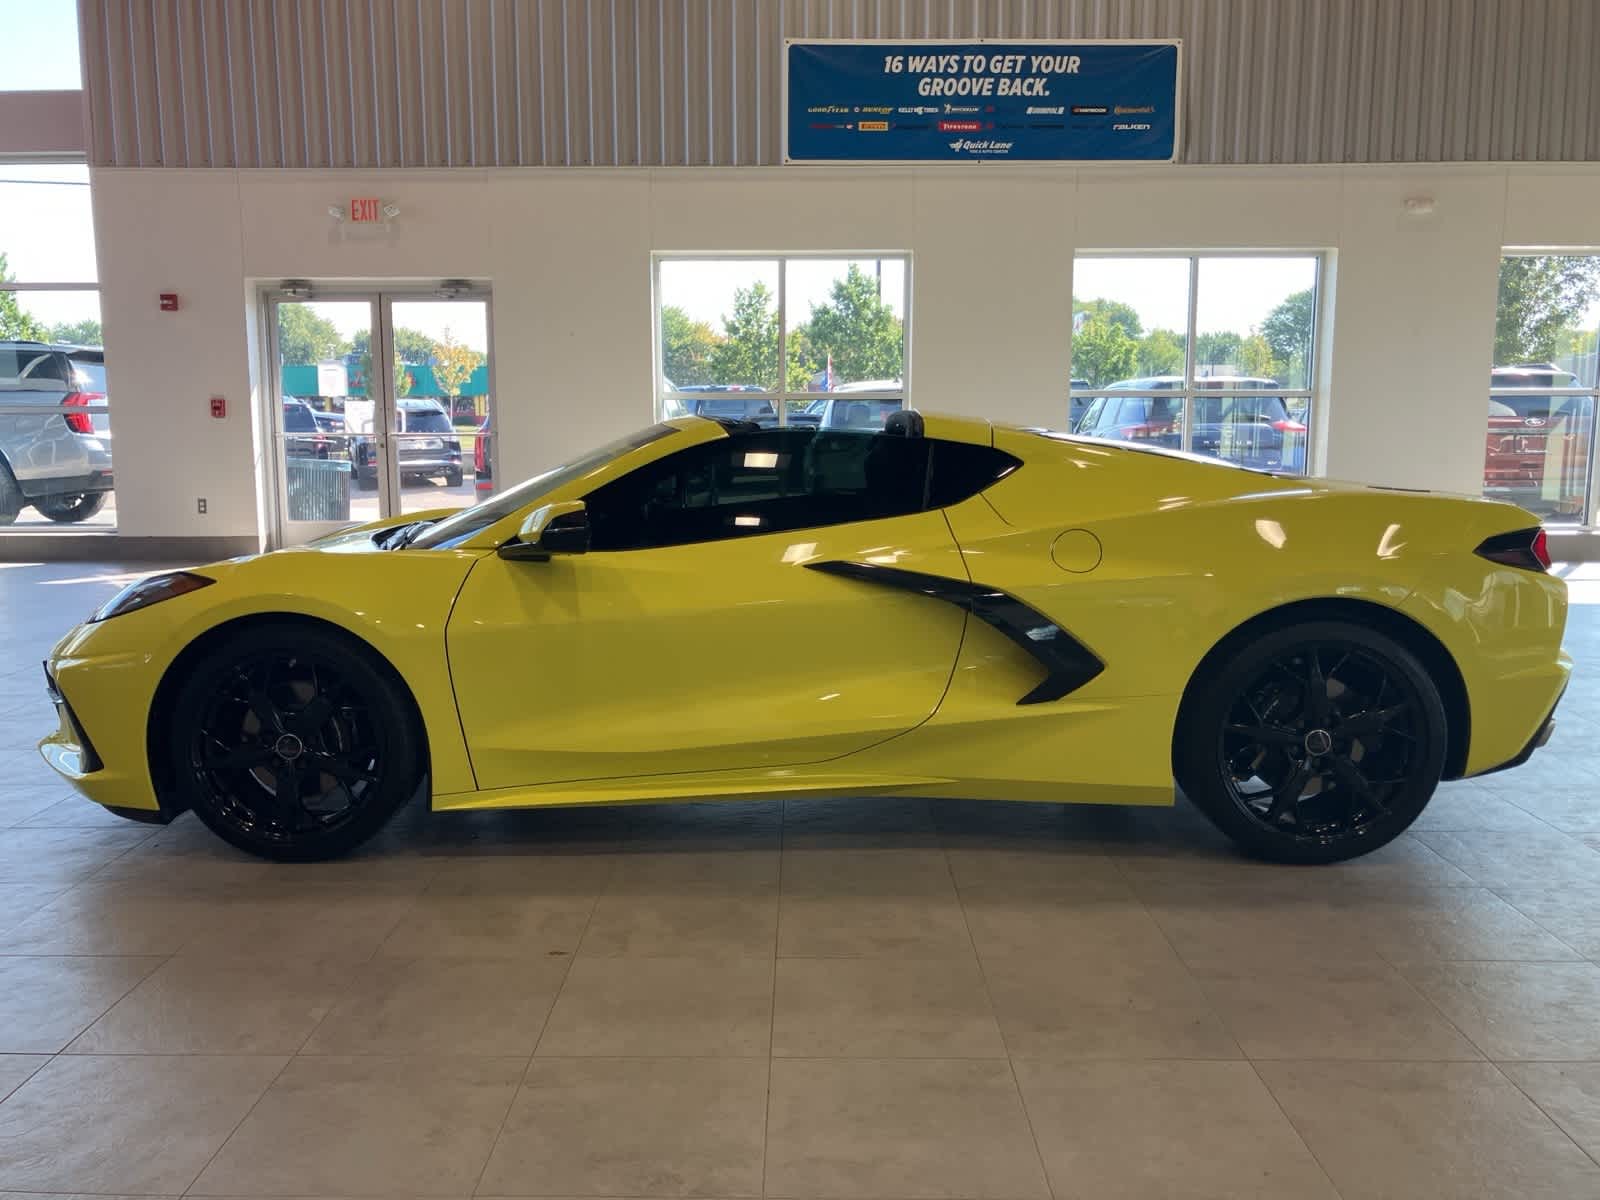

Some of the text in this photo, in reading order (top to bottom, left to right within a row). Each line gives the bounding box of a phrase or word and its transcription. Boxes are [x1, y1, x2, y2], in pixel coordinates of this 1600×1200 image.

[884, 55, 1081, 73] 16 WAYS TO GET YOUR
[918, 77, 1050, 96] GROOVE BACK.
[963, 141, 1013, 150] Quick Lane
[351, 199, 379, 221] EXIT
